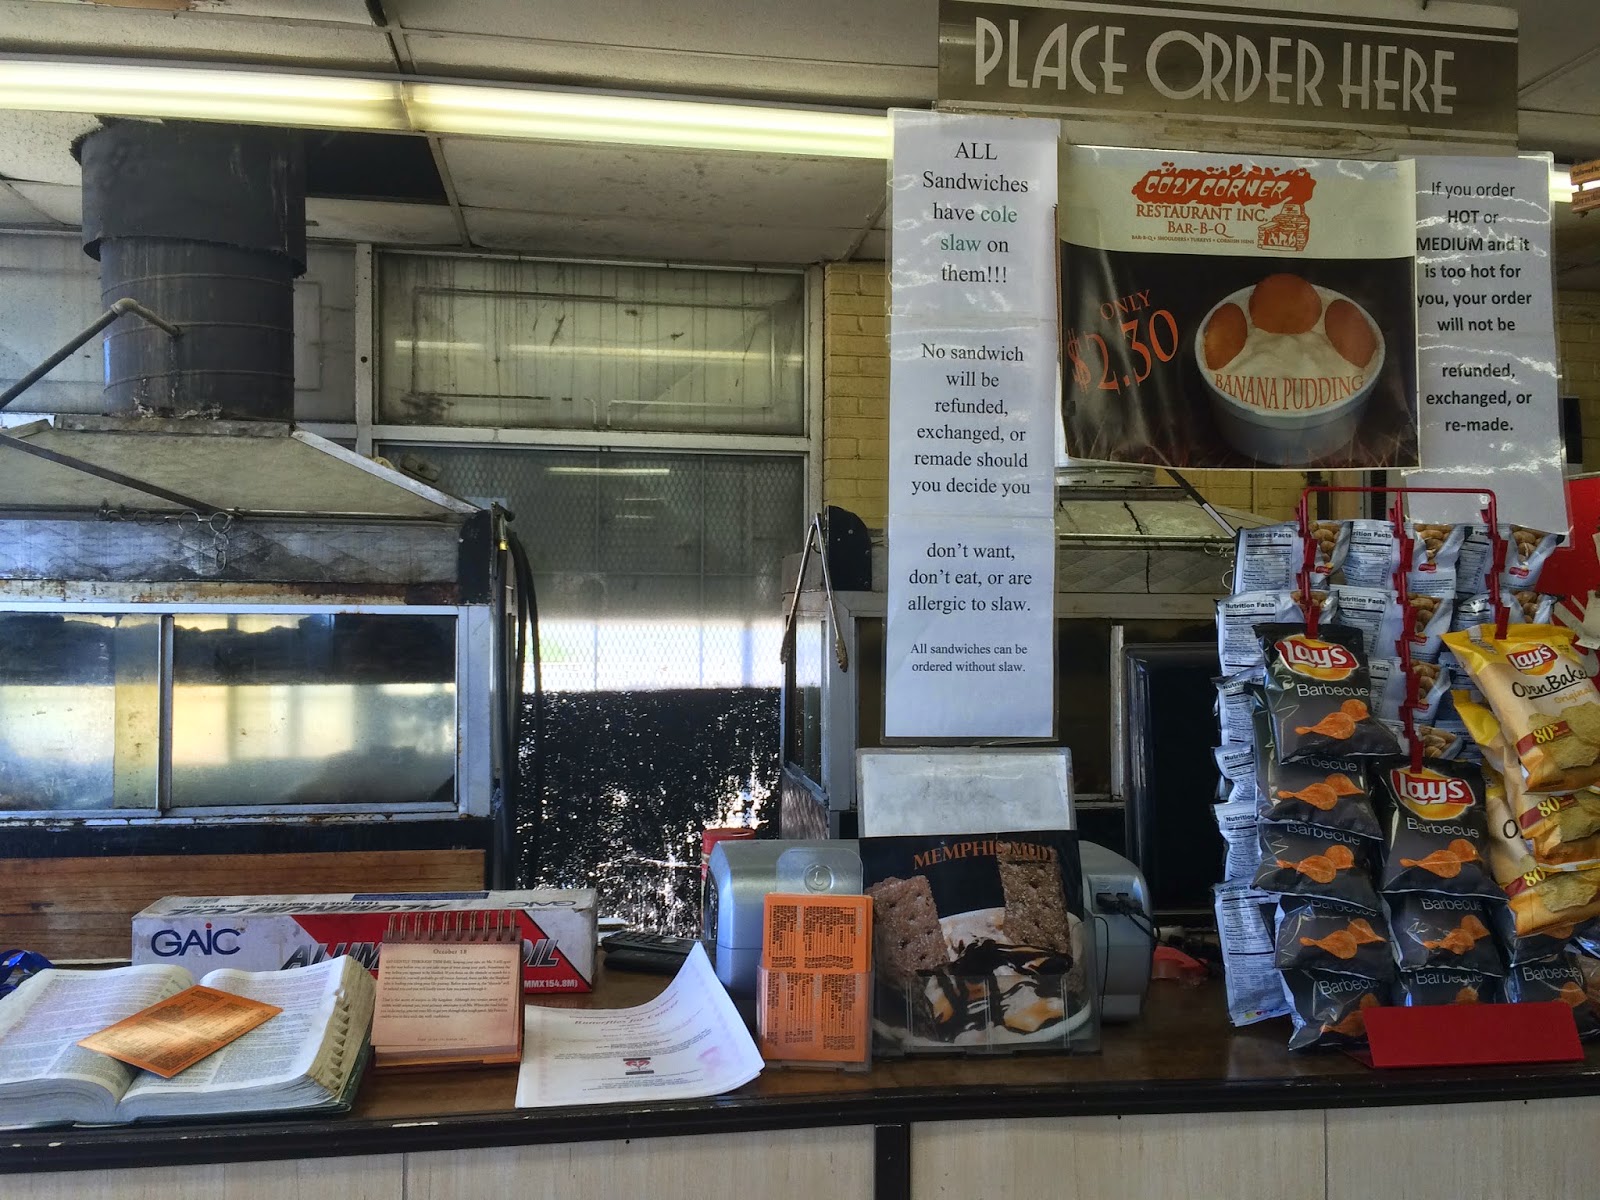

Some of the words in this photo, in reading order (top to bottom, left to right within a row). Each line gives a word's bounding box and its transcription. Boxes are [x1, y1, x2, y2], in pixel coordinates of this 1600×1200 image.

[975, 17, 1127, 95] PLACE
[1145, 29, 1324, 107] ORDER
[1338, 43, 1458, 115] HERE
[954, 142, 998, 160] ALL
[922, 170, 1029, 192] Sandwiches
[1144, 175, 1200, 196] COZY
[1199, 178, 1291, 199] CORNER
[1431, 182, 1442, 196] If
[1445, 185, 1471, 200] you
[1476, 183, 1515, 197] order
[933, 203, 975, 221] have
[980, 205, 1018, 223] cole
[1136, 204, 1233, 220] RESTAURANT
[1237, 208, 1268, 222] INC.
[1447, 210, 1480, 224] HOT
[1483, 213, 1499, 224] or
[940, 234, 982, 252] slaw
[987, 239, 1009, 252] on
[1416, 237, 1483, 251] MEDIUM
[1487, 237, 1515, 251] and
[1519, 237, 1530, 251] it
[941, 265, 1007, 283] them!!!
[1425, 264, 1436, 278] is
[1440, 265, 1466, 278] too
[1470, 264, 1496, 278] hot
[1499, 264, 1521, 278] for
[1100, 289, 1151, 321] ONLY
[1417, 293, 1449, 308] you,
[1453, 293, 1487, 308] your
[1491, 290, 1532, 305] order
[1437, 317, 1464, 331] will
[1468, 318, 1493, 331] not
[1498, 317, 1516, 331] be
[921, 343, 946, 359] No
[950, 344, 1025, 362] sandwich
[1067, 309, 1179, 395] $2.30
[946, 371, 976, 387] will
[981, 372, 1000, 388] be
[1442, 362, 1515, 380] refunded,
[1214, 373, 1279, 410] BANANA
[1282, 374, 1365, 411] PUDDING
[1426, 391, 1511, 408] exchanged,
[1516, 393, 1532, 404] or
[935, 399, 1009, 416] refunded,
[917, 424, 1005, 444] exchanged,
[1009, 429, 1026, 442] or
[1445, 418, 1514, 432] re-made.
[914, 452, 972, 467] remade
[976, 453, 1028, 468] should
[911, 481, 941, 496] you
[946, 478, 998, 494] decide
[1001, 483, 1031, 498] you
[926, 543, 968, 559] don’t
[973, 545, 1016, 561] want,
[908, 570, 950, 585] don’t
[955, 571, 983, 587] eat,
[987, 573, 1004, 585] or
[1008, 573, 1032, 586] are
[907, 596, 966, 615] allergic
[971, 598, 986, 612] to
[991, 596, 1031, 613] slaw.
[910, 643, 928, 655] All
[930, 644, 991, 655] sandwiches
[993, 645, 1012, 655] can
[1015, 644, 1028, 655] be
[911, 661, 953, 672] ordered
[956, 661, 996, 672] without
[998, 661, 1026, 672] slaw.
[1296, 683, 1370, 697] Barbecue
[1406, 817, 1480, 839] Barbecue
[913, 841, 1004, 870] MEMPHIS
